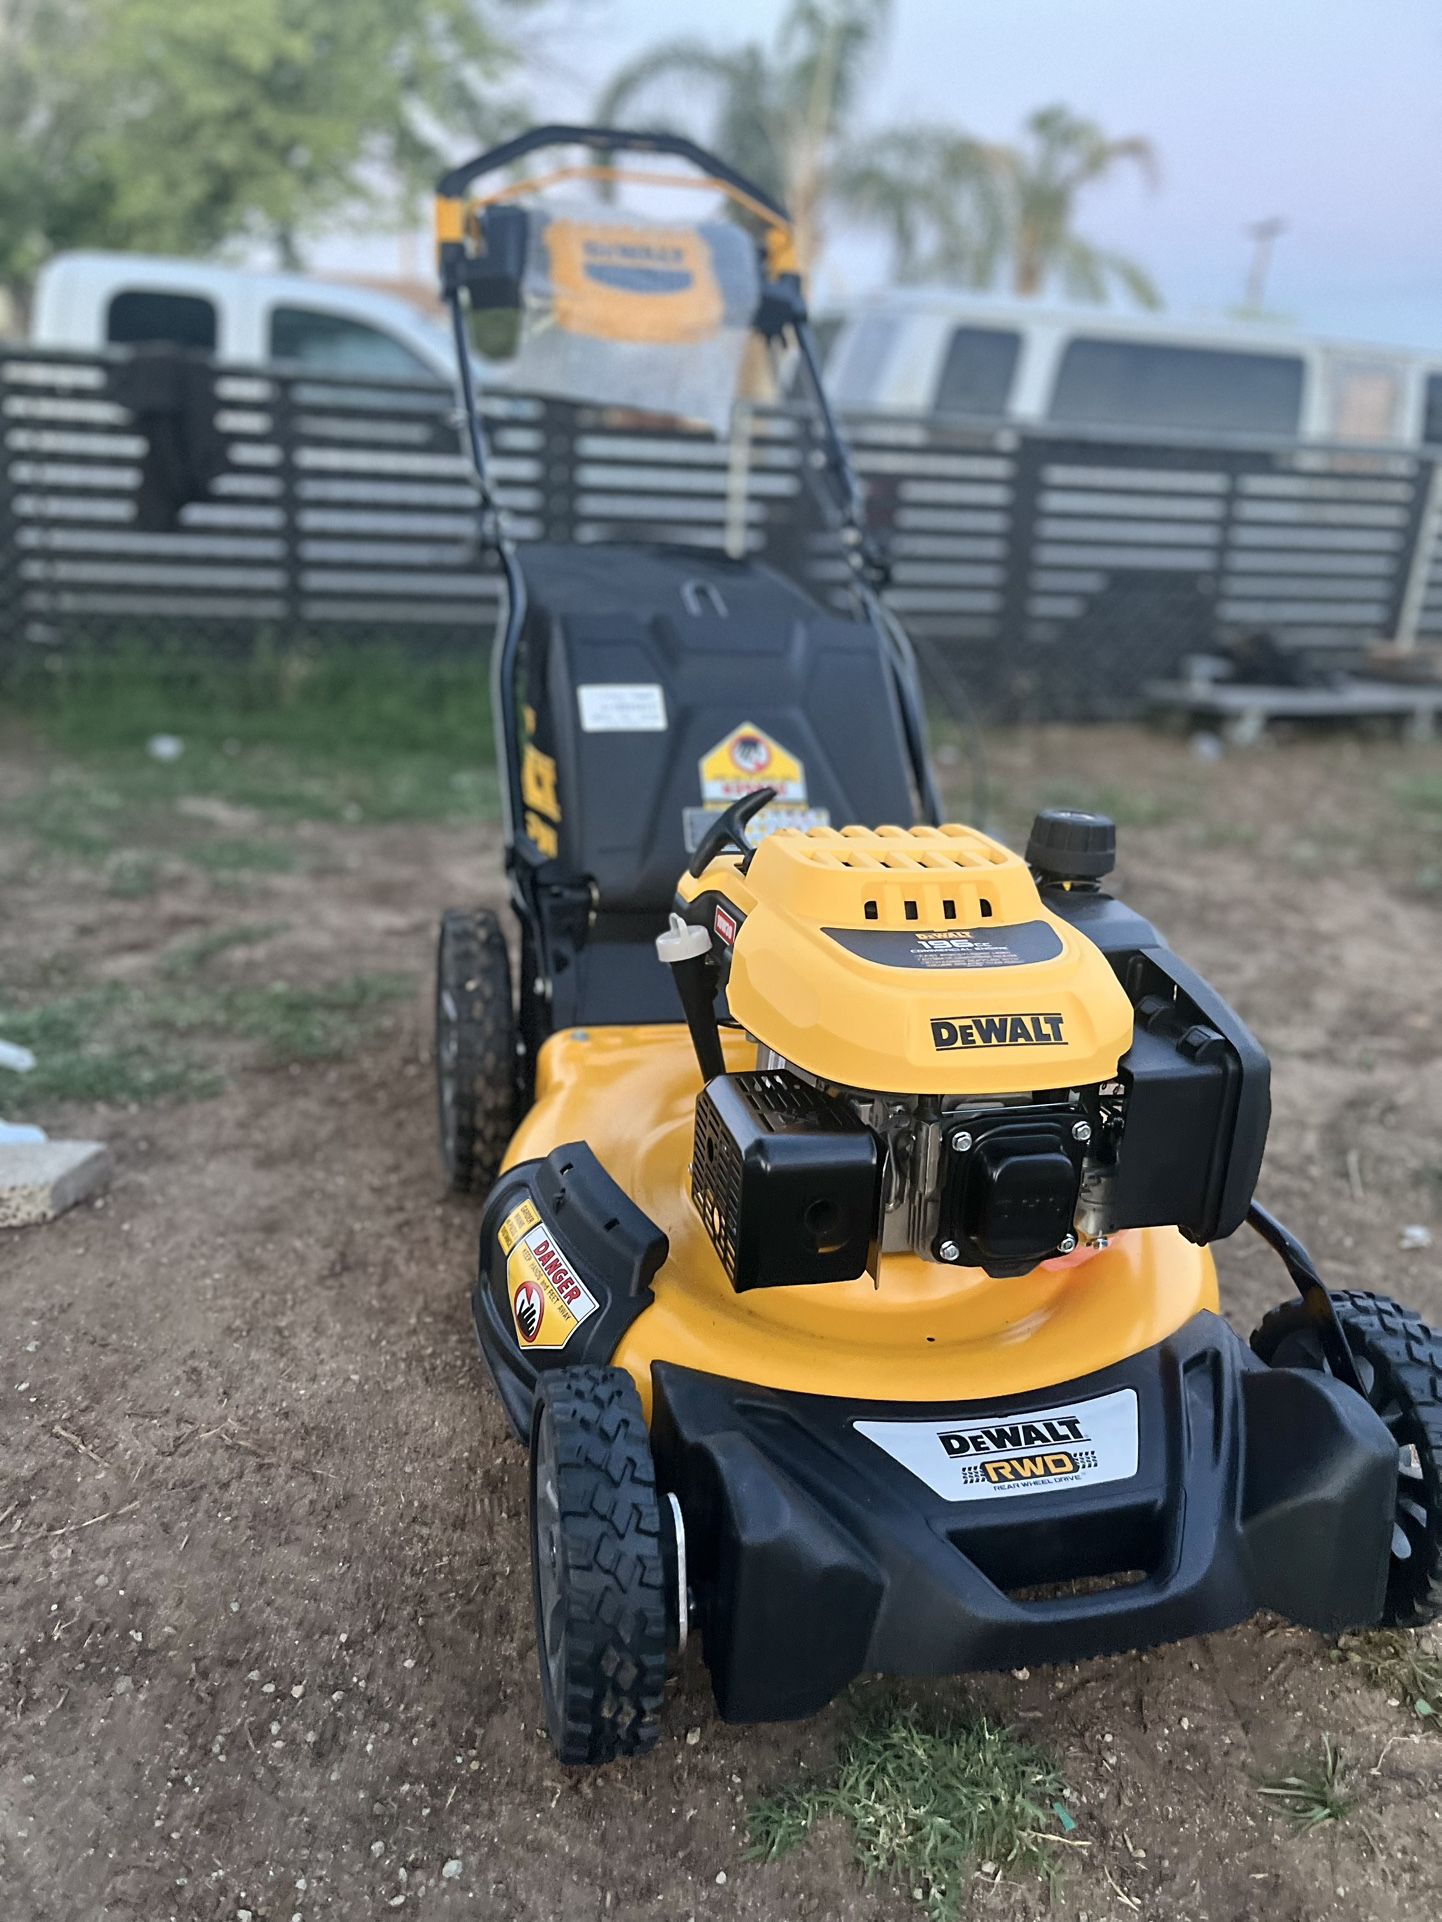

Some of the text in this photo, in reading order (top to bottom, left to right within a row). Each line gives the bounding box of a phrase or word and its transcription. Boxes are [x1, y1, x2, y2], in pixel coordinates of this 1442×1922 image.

[522, 1248, 533, 1262] KEEP
[529, 1262, 543, 1281] HANDS
[547, 1288, 560, 1304] FEET
[557, 1304, 572, 1321] AWAY
[533, 1239, 582, 1305] DANGER
[984, 1453, 1075, 1483] RWD
[993, 1474, 1082, 1492] REAR WHEEL DRIVE
